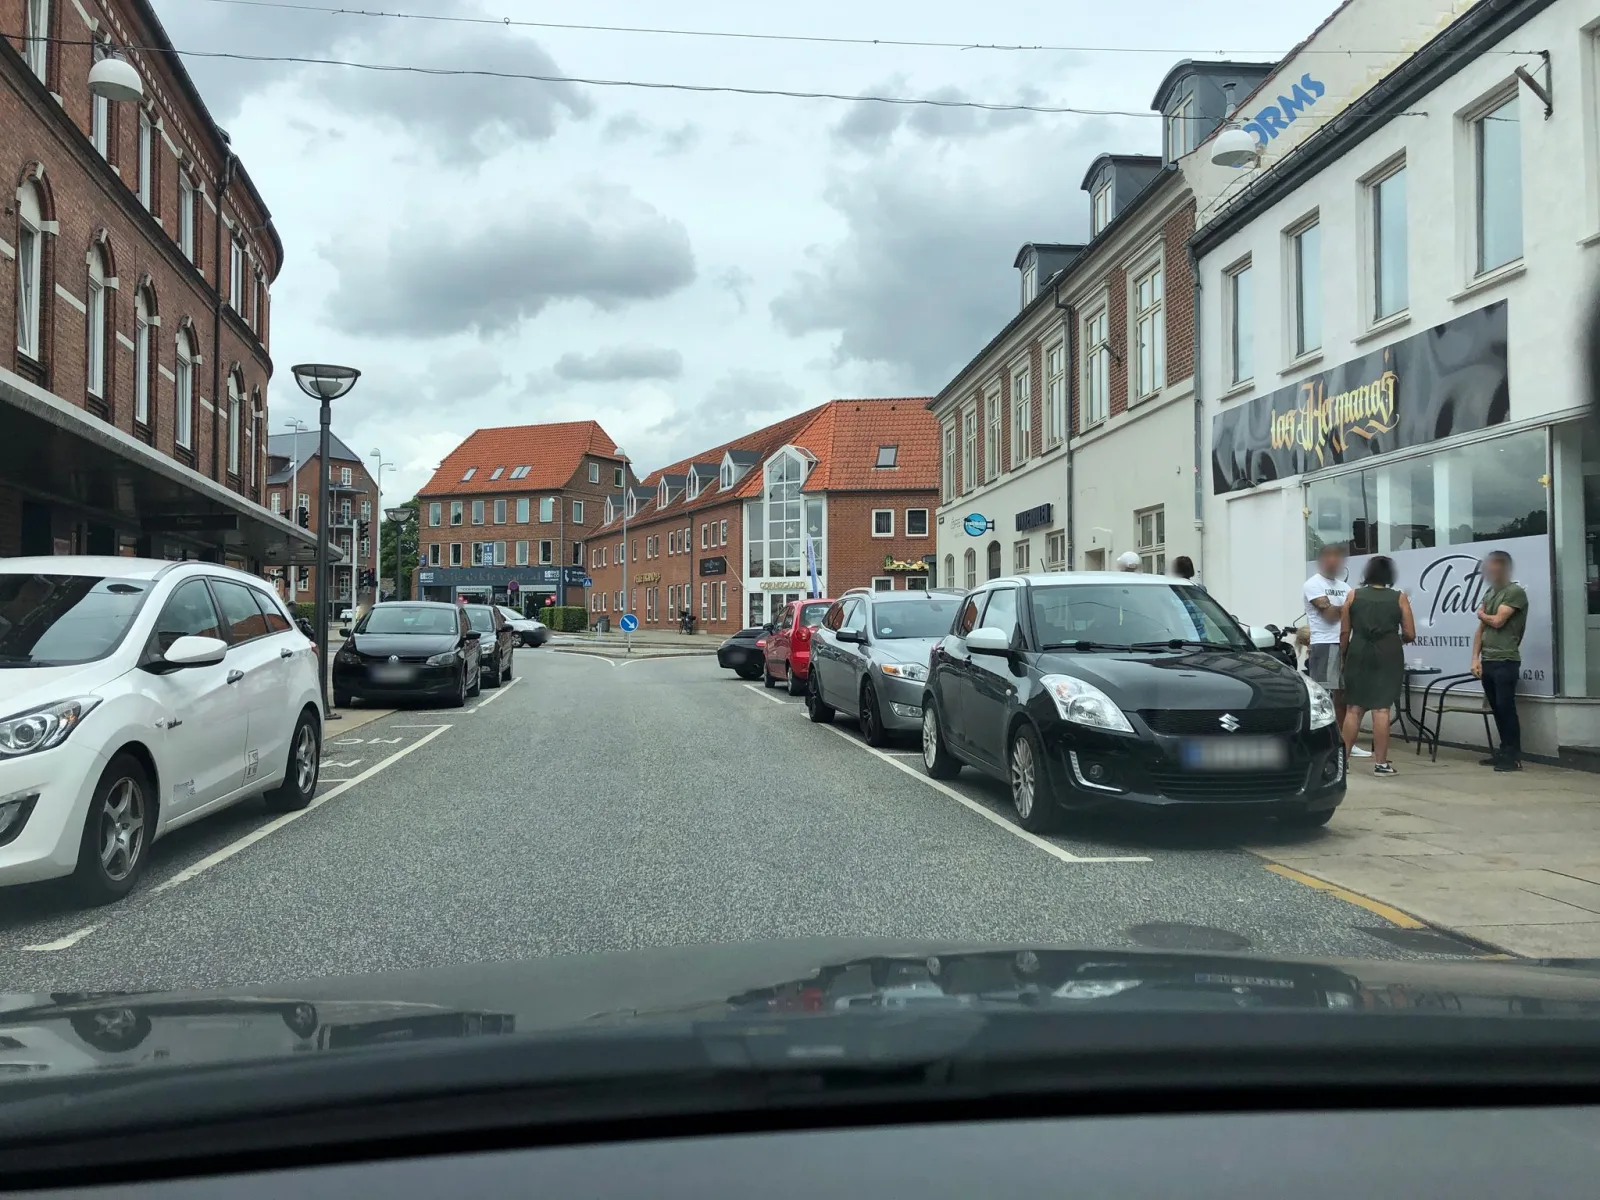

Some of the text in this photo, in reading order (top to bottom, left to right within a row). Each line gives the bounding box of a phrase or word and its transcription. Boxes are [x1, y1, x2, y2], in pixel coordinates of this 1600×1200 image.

[1240, 73, 1325, 148] ORMS
[1411, 635, 1470, 648] KREATIVITET
[1523, 669, 1545, 681] 62 03
